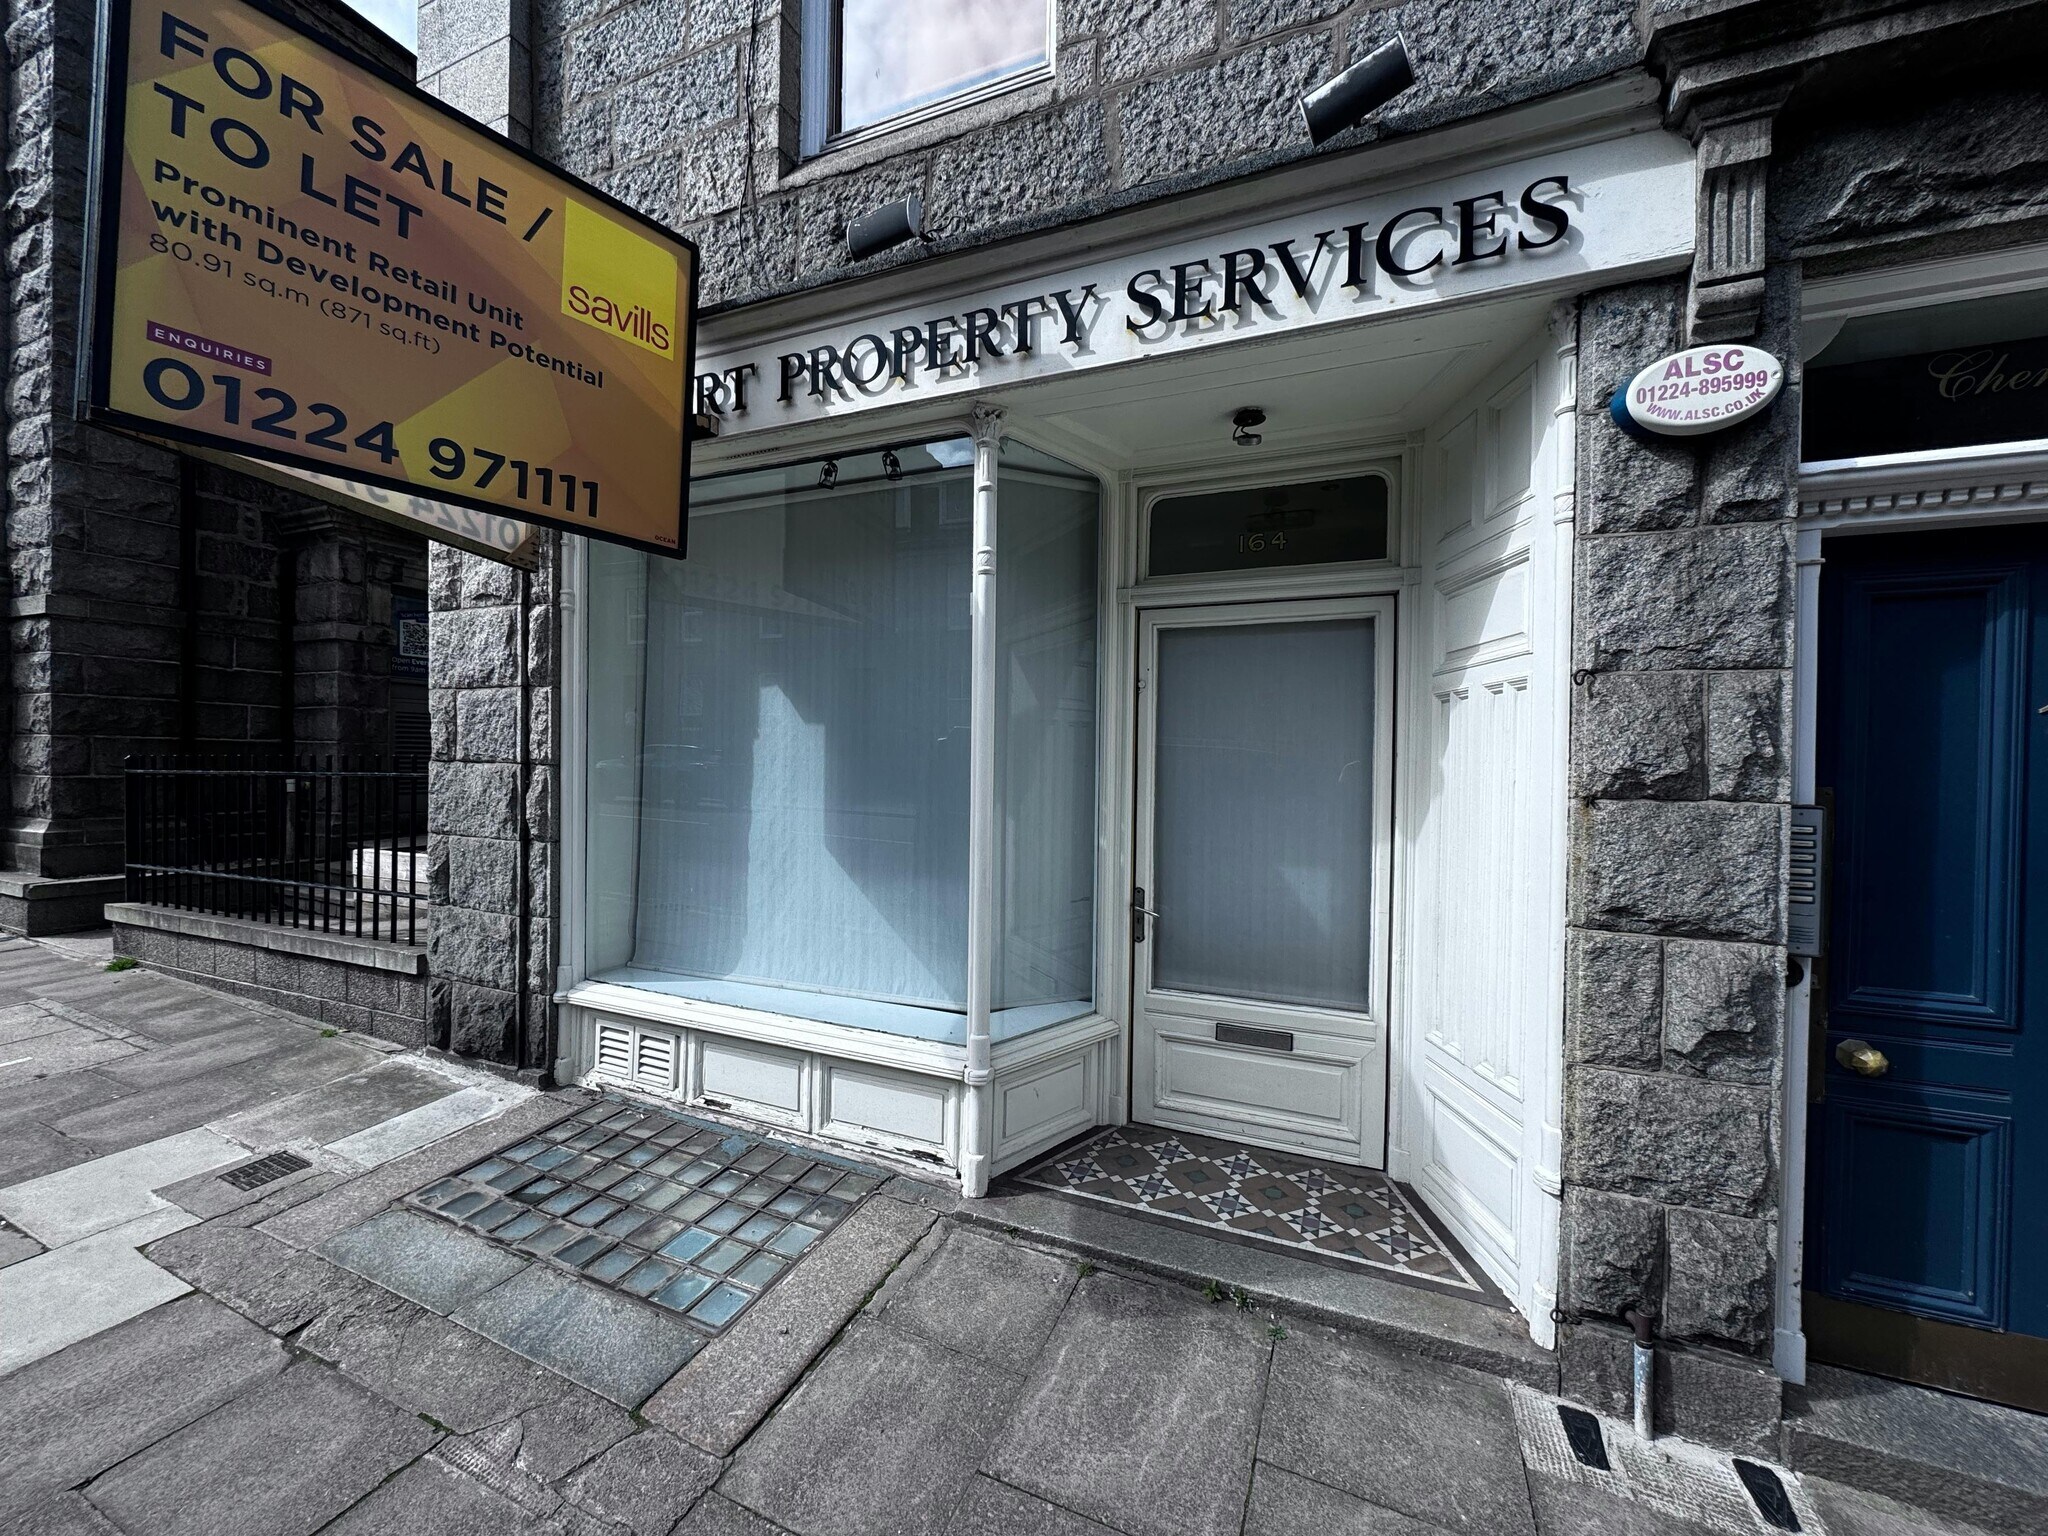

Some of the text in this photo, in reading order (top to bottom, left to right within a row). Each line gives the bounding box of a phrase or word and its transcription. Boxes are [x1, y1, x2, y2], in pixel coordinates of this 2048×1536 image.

[160, 11, 553, 242] FOR SALE /
[154, 82, 423, 240] TO LET
[154, 158, 523, 331] Prominent Retail Unit
[149, 233, 440, 354] 80.91 sq.m (871 sq.ft)
[151, 200, 603, 388] with Development Potential
[776, 283, 1098, 402] PROPERTY
[1125, 175, 1569, 330] SERVICES
[568, 285, 669, 350] savills
[154, 328, 265, 370] ENQUIRIES
[1662, 349, 1744, 381] ALSC
[1636, 370, 1768, 405] 01224-895999
[1646, 388, 1766, 421] WWW.ALSC.CO.UK
[143, 357, 399, 464] 01224
[428, 437, 598, 518] 971111
[654, 535, 676, 544] OCEAN
[1238, 531, 1287, 553] 164
[392, 656, 410, 665] Open
[392, 664, 409, 672] from
